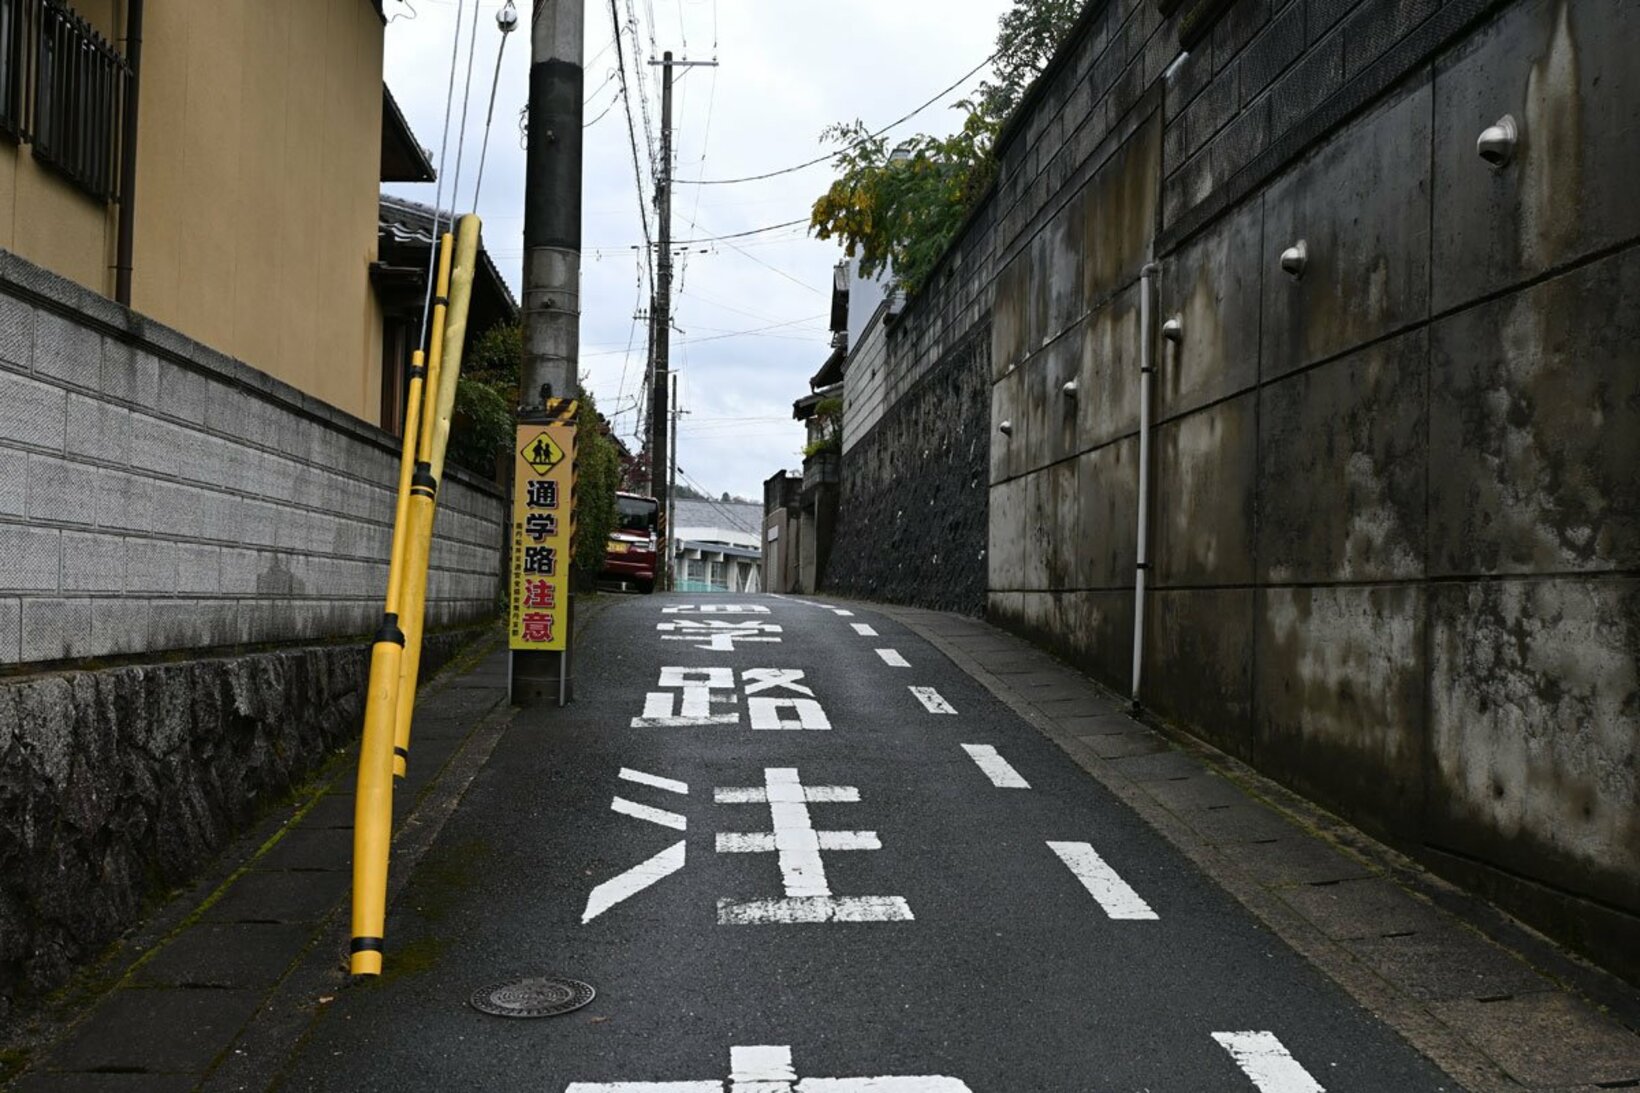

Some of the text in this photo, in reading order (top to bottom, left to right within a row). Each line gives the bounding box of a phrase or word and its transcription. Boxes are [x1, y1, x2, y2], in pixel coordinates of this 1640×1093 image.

[522, 480, 558, 642] 通学路注意
